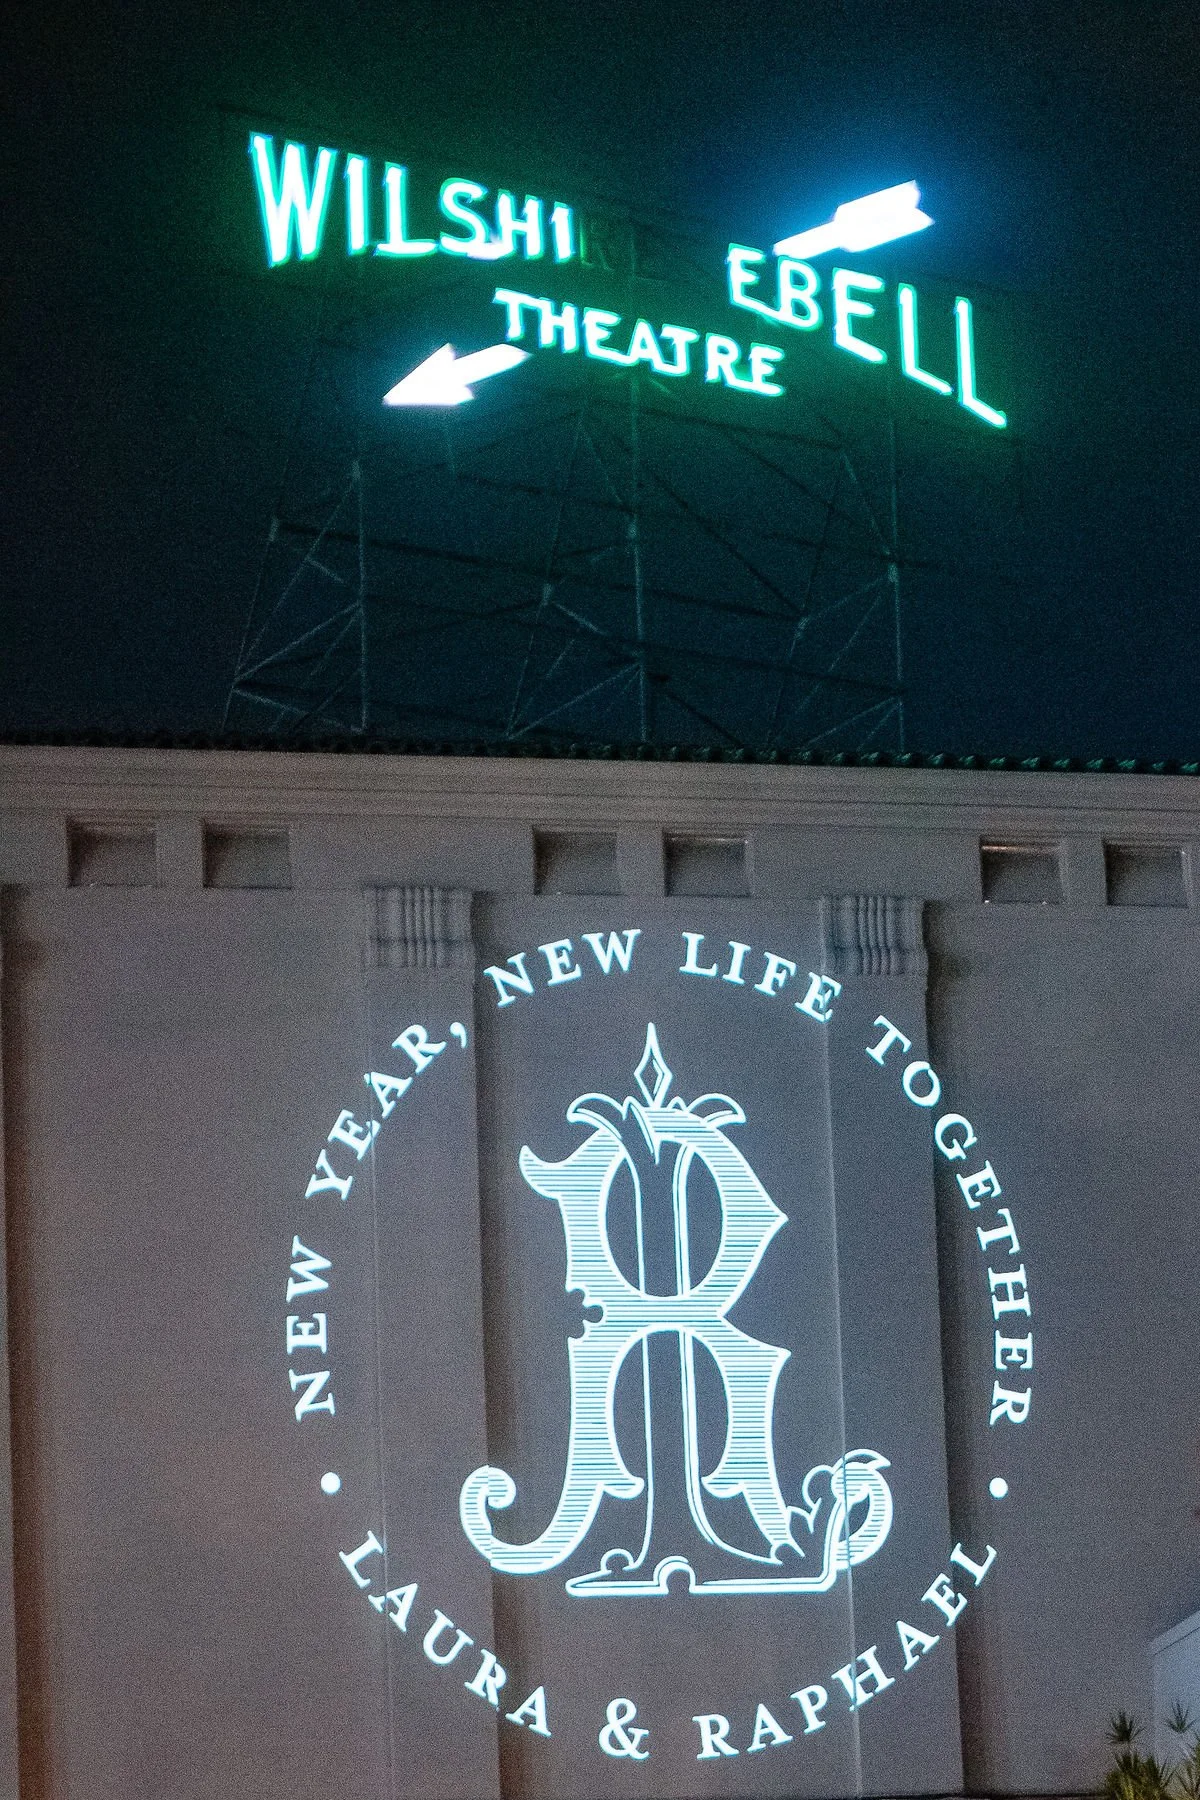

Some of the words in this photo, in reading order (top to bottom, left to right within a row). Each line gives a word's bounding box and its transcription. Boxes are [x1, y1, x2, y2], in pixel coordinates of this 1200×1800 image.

[247, 129, 664, 283] WILSHI
[724, 241, 1008, 431] EBELL
[491, 285, 787, 399] THEATRE
[483, 928, 642, 1008] NEW
[678, 931, 843, 1024] LIFE
[304, 1021, 469, 1202] YEAR,
[864, 1013, 1035, 1427] TOGETHER
[284, 1234, 336, 1423] NEW
[337, 1529, 553, 1738] LAURA
[597, 1696, 651, 1761] &
[691, 1541, 998, 1762] RAPHAEL
